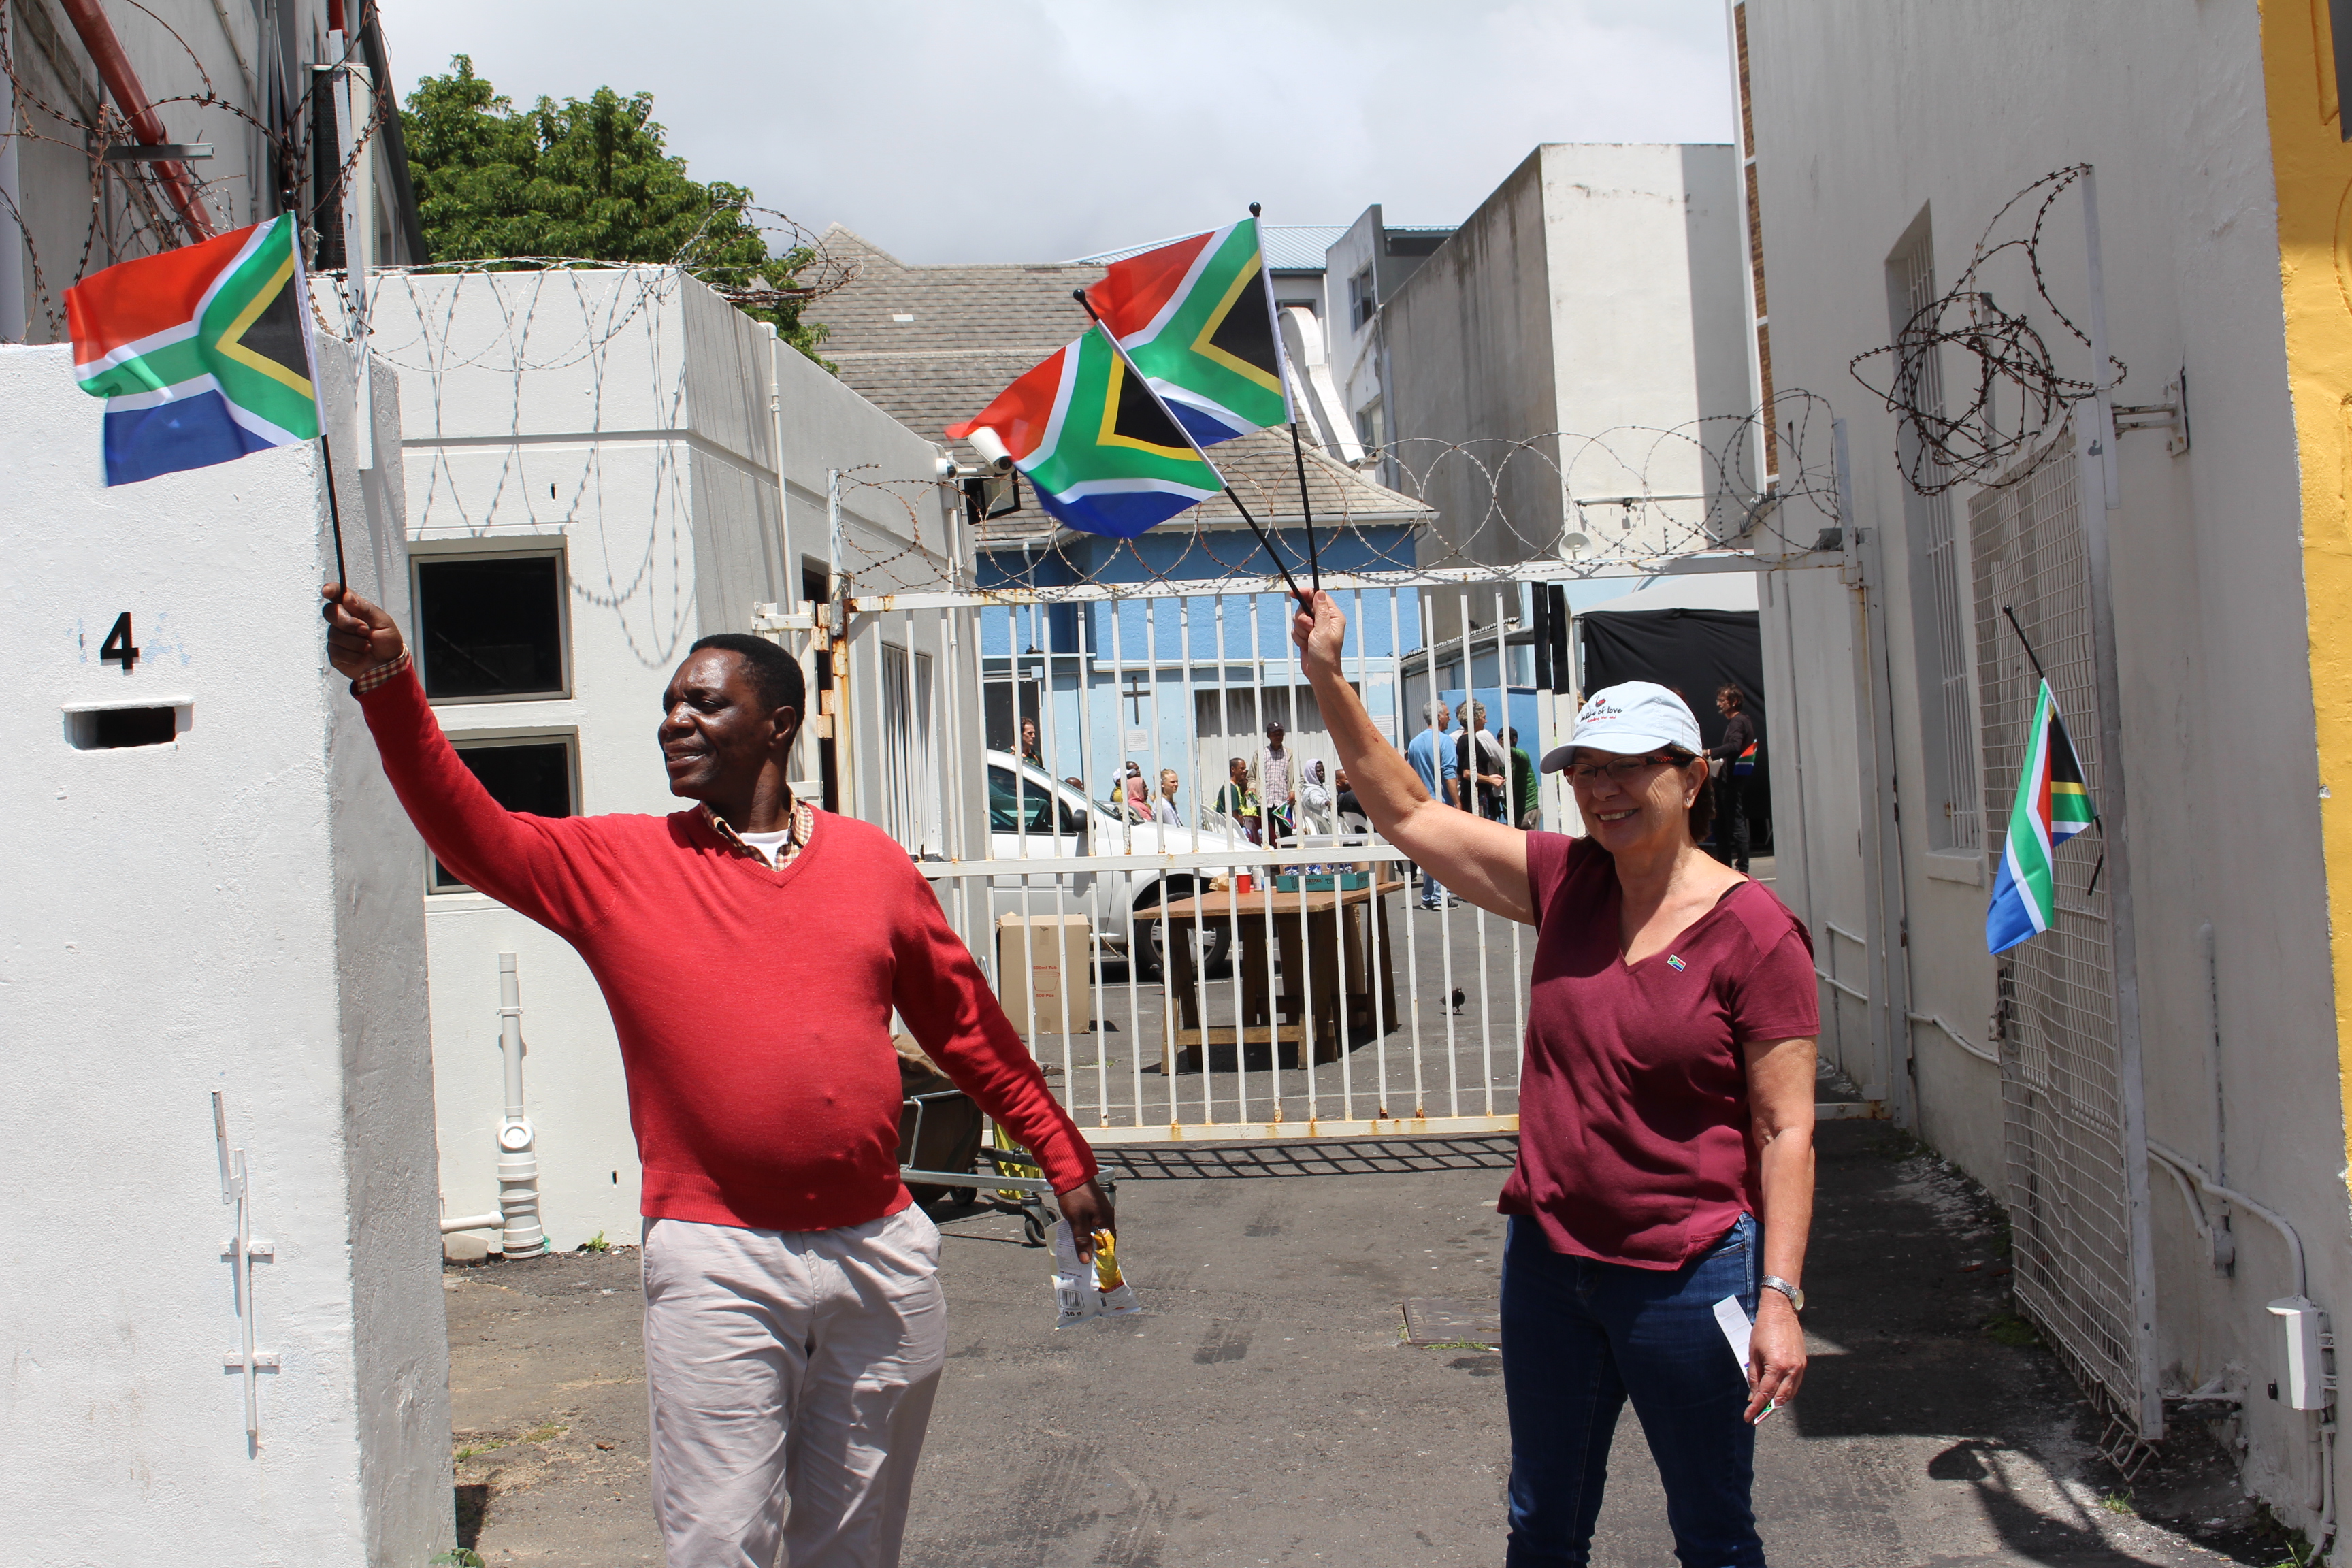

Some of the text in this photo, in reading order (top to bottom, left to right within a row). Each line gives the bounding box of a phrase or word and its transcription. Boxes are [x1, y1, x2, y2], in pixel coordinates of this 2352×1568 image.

[100, 612, 140, 670] 4
[1598, 706, 1606, 715] of
[1607, 706, 1623, 714] love
